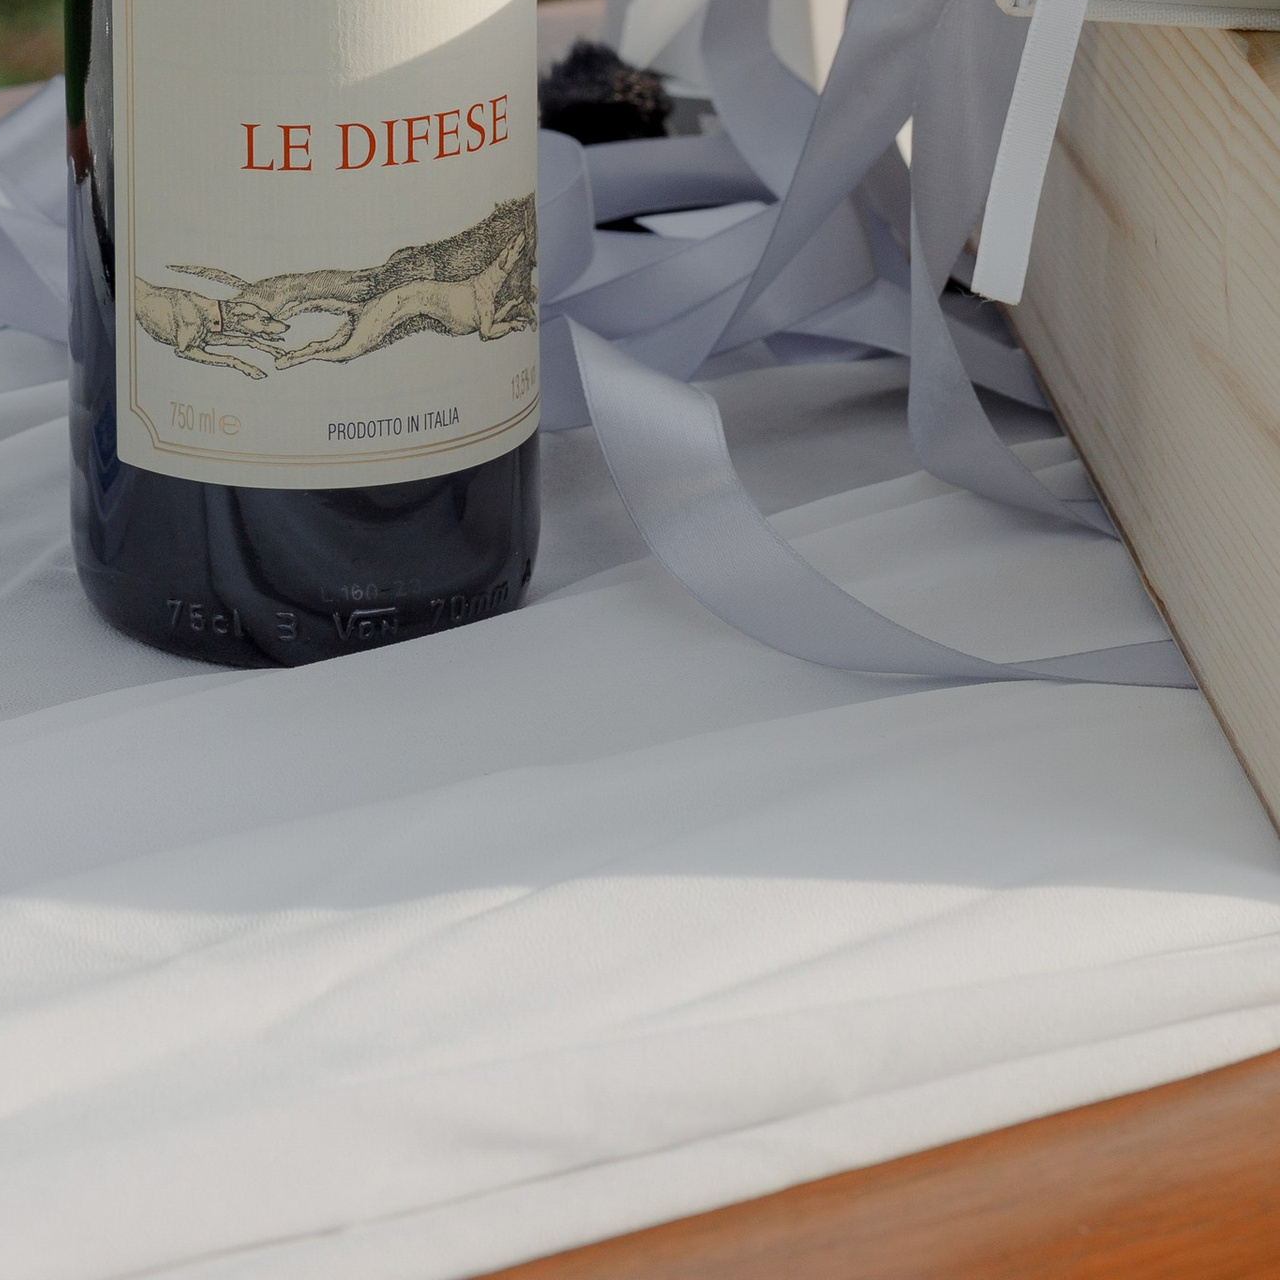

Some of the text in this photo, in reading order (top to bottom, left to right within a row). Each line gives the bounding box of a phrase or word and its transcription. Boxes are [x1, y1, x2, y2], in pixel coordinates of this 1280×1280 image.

[240, 94, 509, 171] LE DIFESE
[170, 401, 195, 431] 750
[199, 408, 215, 434] ml
[327, 407, 460, 441] PRODOTTO IN ITALIA
[166, 598, 240, 637] 75cl
